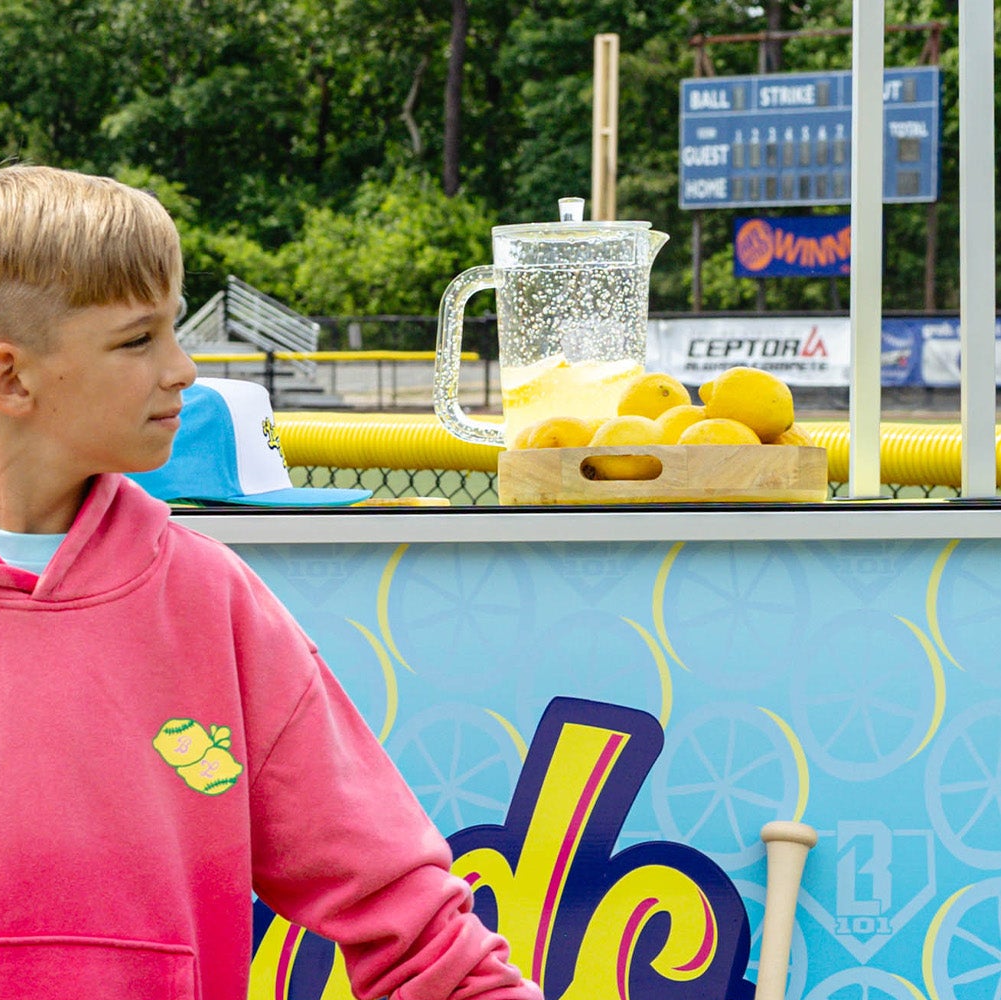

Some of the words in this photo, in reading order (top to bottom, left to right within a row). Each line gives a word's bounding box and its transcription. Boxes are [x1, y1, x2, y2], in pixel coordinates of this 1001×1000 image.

[689, 90, 731, 109] BALL
[760, 84, 816, 106] STRIKE
[681, 144, 730, 167] GUEST
[684, 178, 727, 200] HOME
[836, 917, 893, 934] 101
